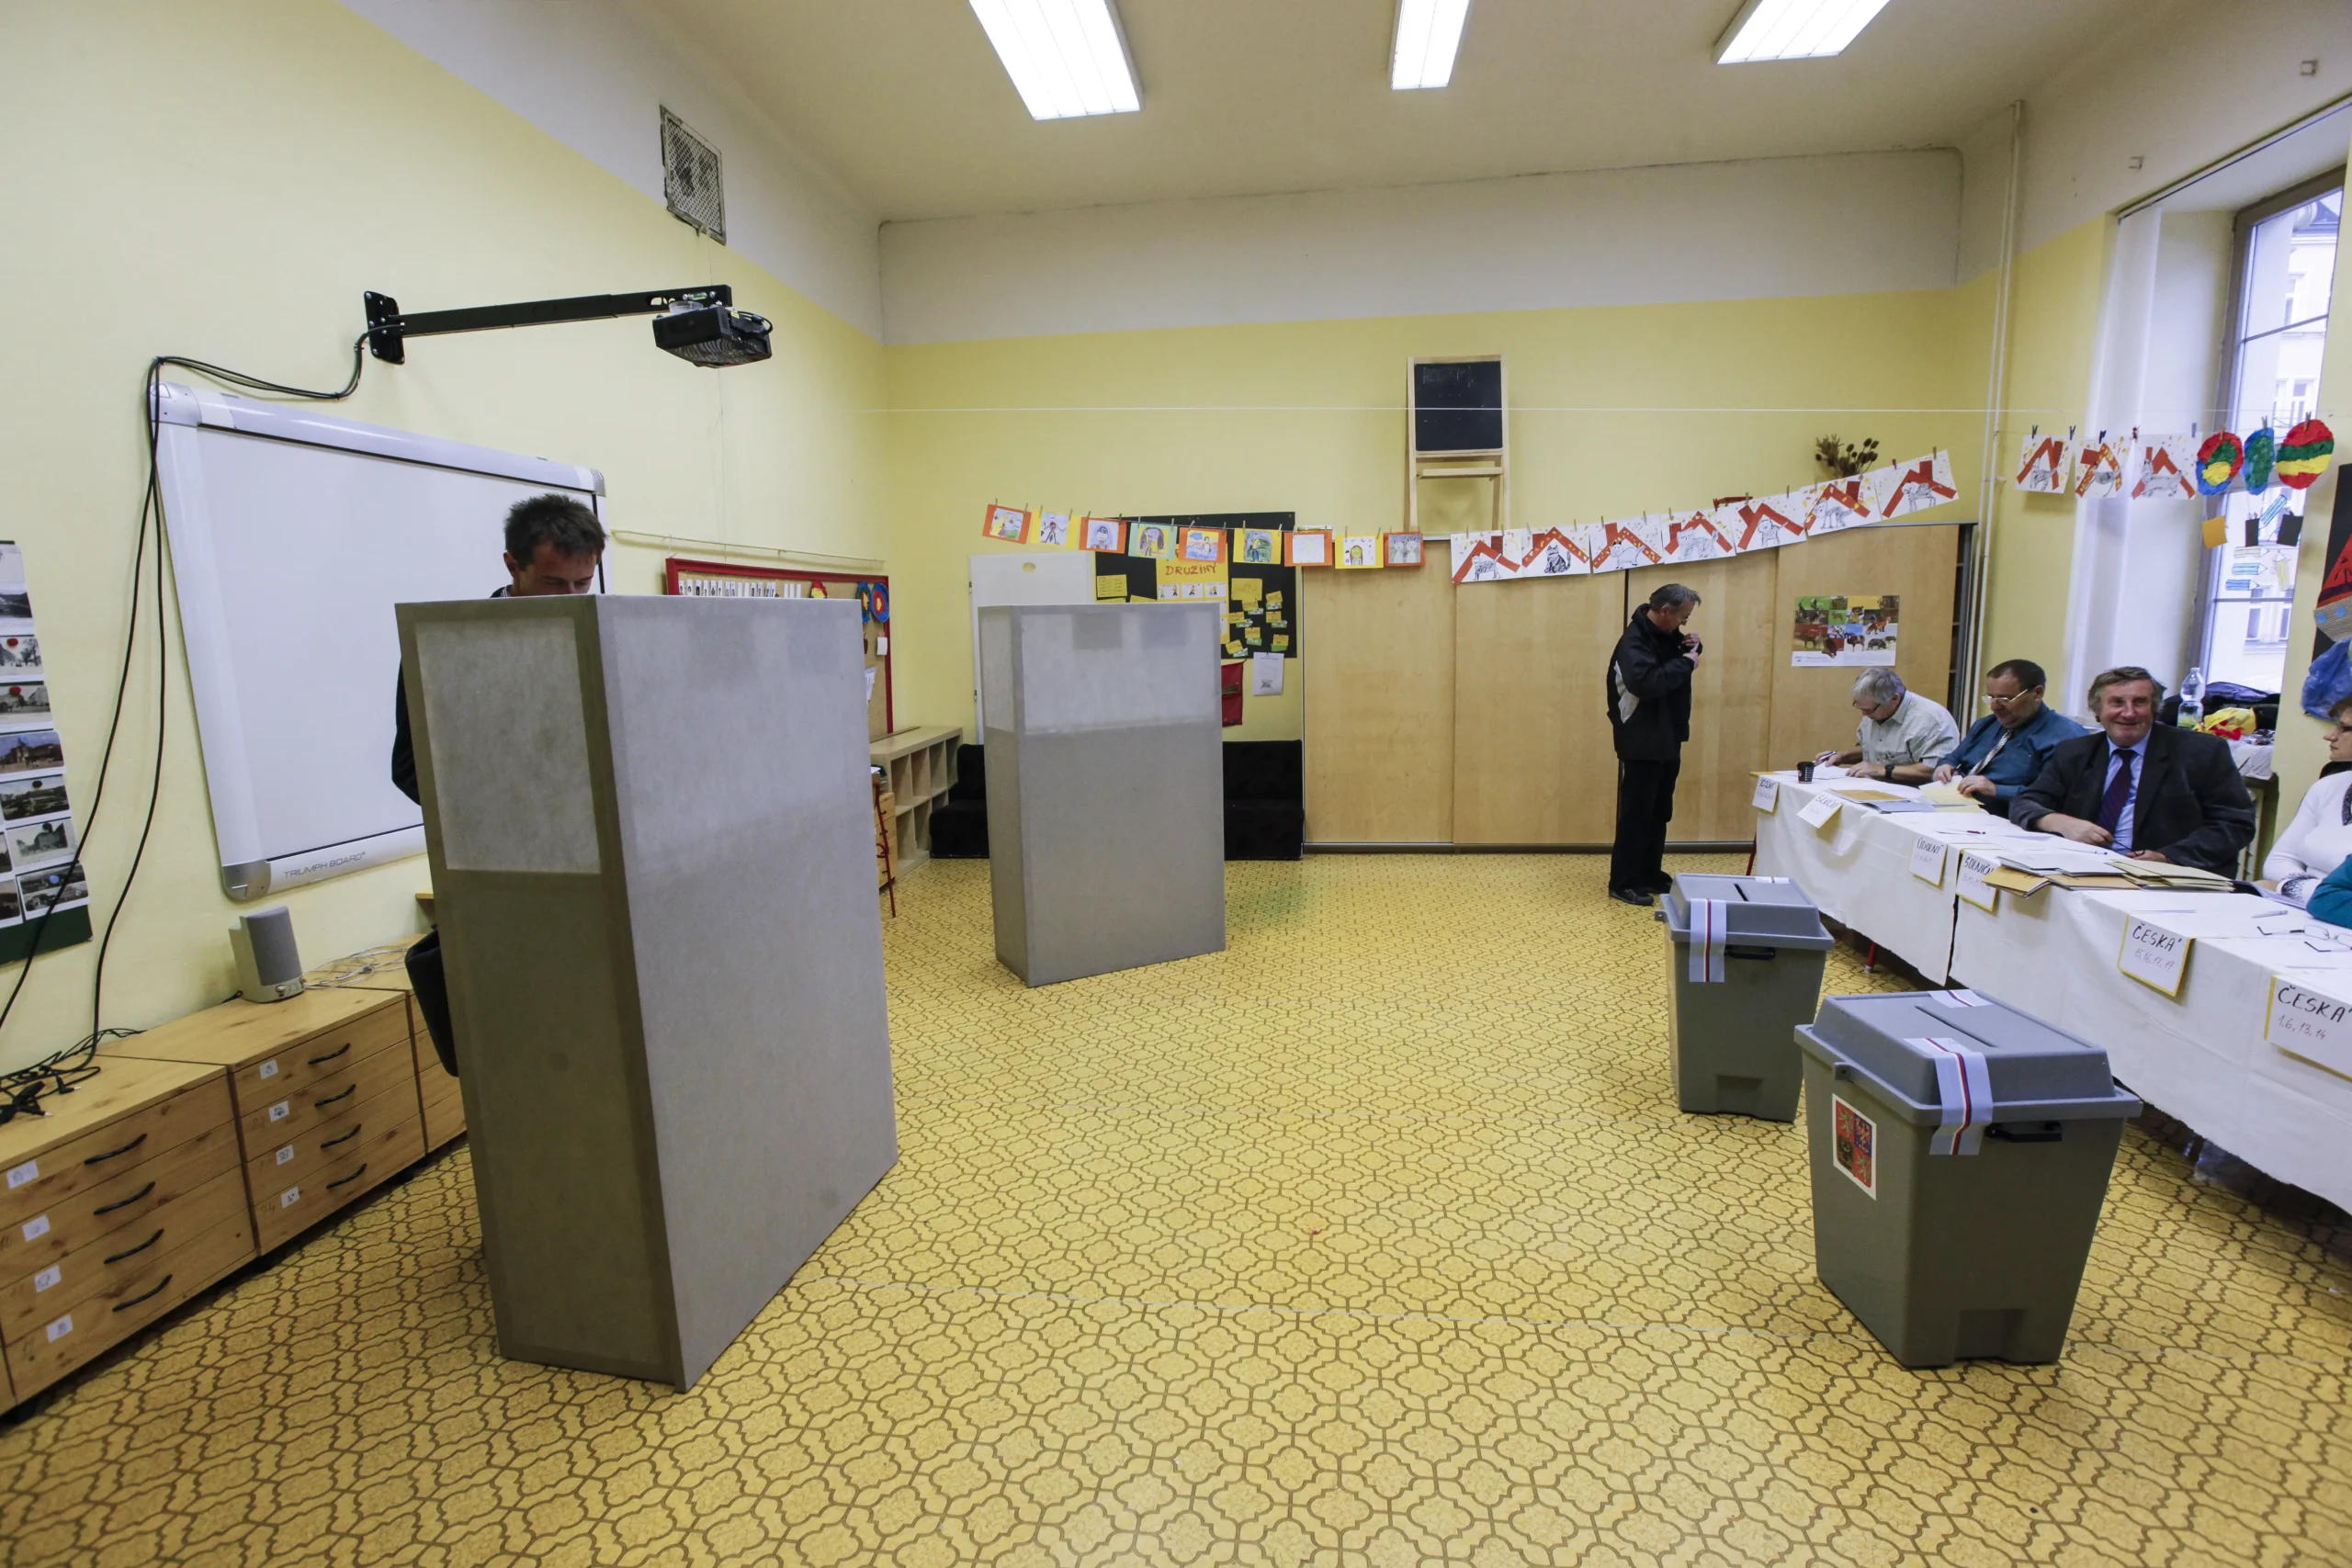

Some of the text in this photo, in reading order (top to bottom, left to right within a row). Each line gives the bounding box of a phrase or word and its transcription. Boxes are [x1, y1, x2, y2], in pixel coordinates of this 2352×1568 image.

[1917, 837, 1944, 854] ÚDOLNÍ
[284, 863, 328, 878] TRIUMPH
[1963, 856, 1995, 875] SOLNIČN
[2132, 922, 2182, 952] ČESKÁ
[2278, 985, 2352, 1022] ČESKÁ
